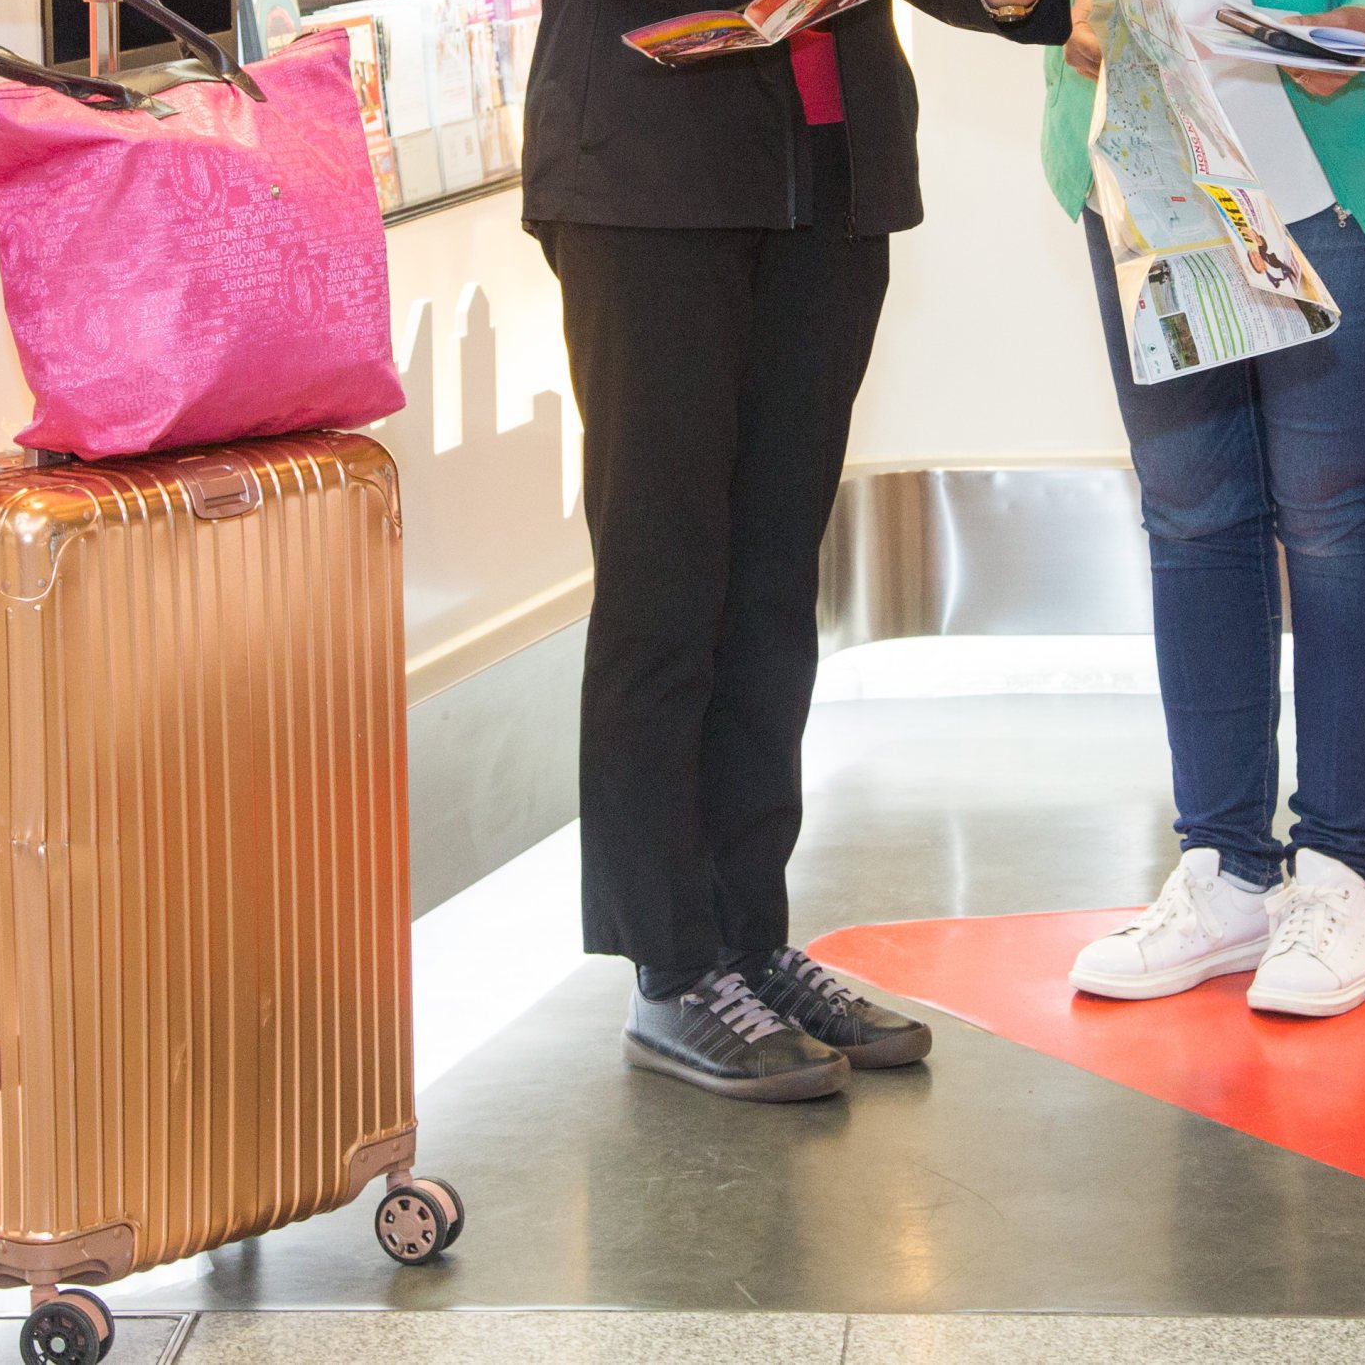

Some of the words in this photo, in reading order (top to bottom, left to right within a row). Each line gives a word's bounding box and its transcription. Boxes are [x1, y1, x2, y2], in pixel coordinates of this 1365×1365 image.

[180, 227, 247, 249] SINGAPORE
[223, 248, 283, 269] SINGAPORE
[221, 270, 281, 291] SINGAPORE
